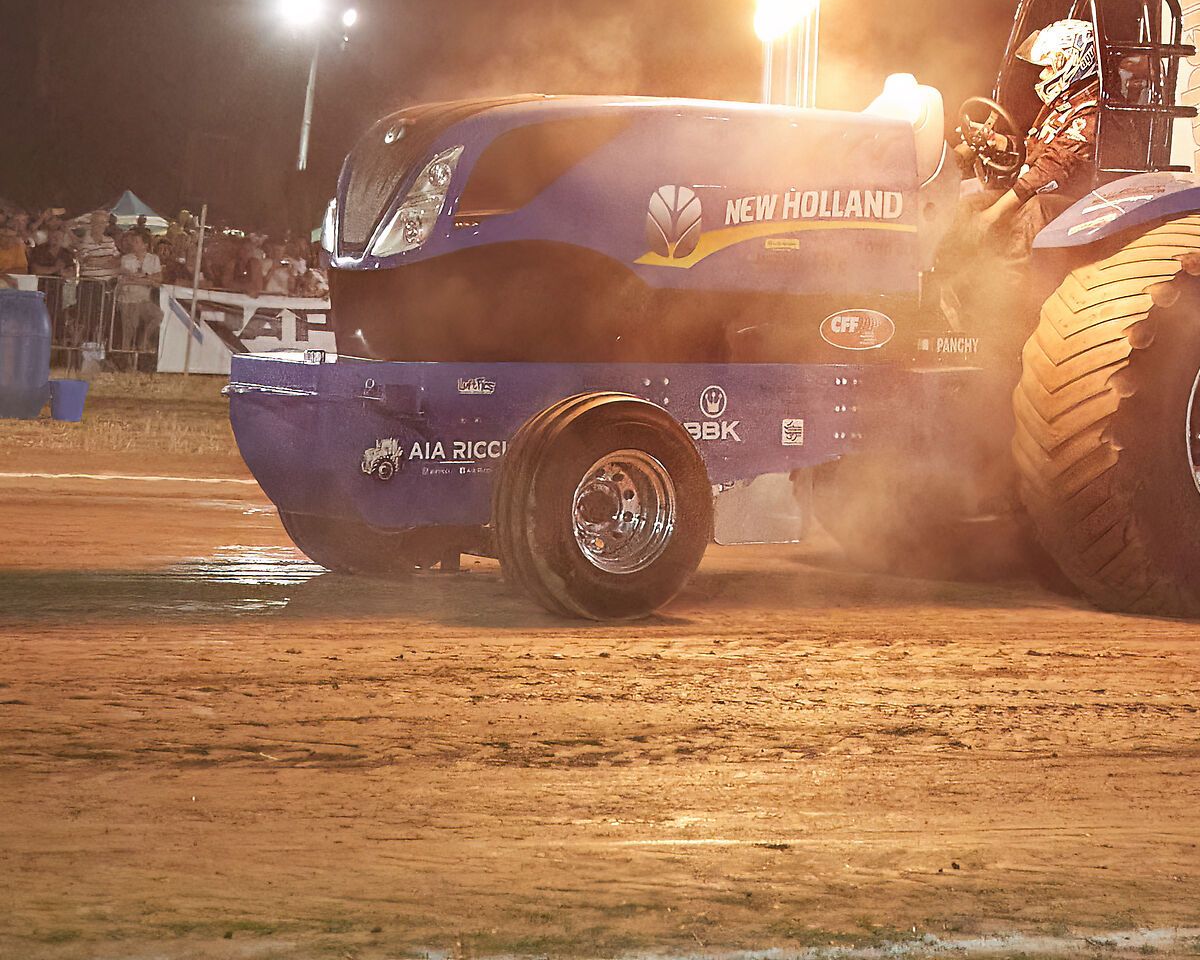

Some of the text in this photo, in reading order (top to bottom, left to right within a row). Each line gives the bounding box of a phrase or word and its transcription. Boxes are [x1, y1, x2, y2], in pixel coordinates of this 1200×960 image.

[724, 189, 904, 225] NEW HOLLAND
[830, 316, 860, 333] CFF
[936, 337, 979, 354] PANCHY
[684, 421, 742, 442] BBK
[408, 440, 508, 460] AIA RICCI
